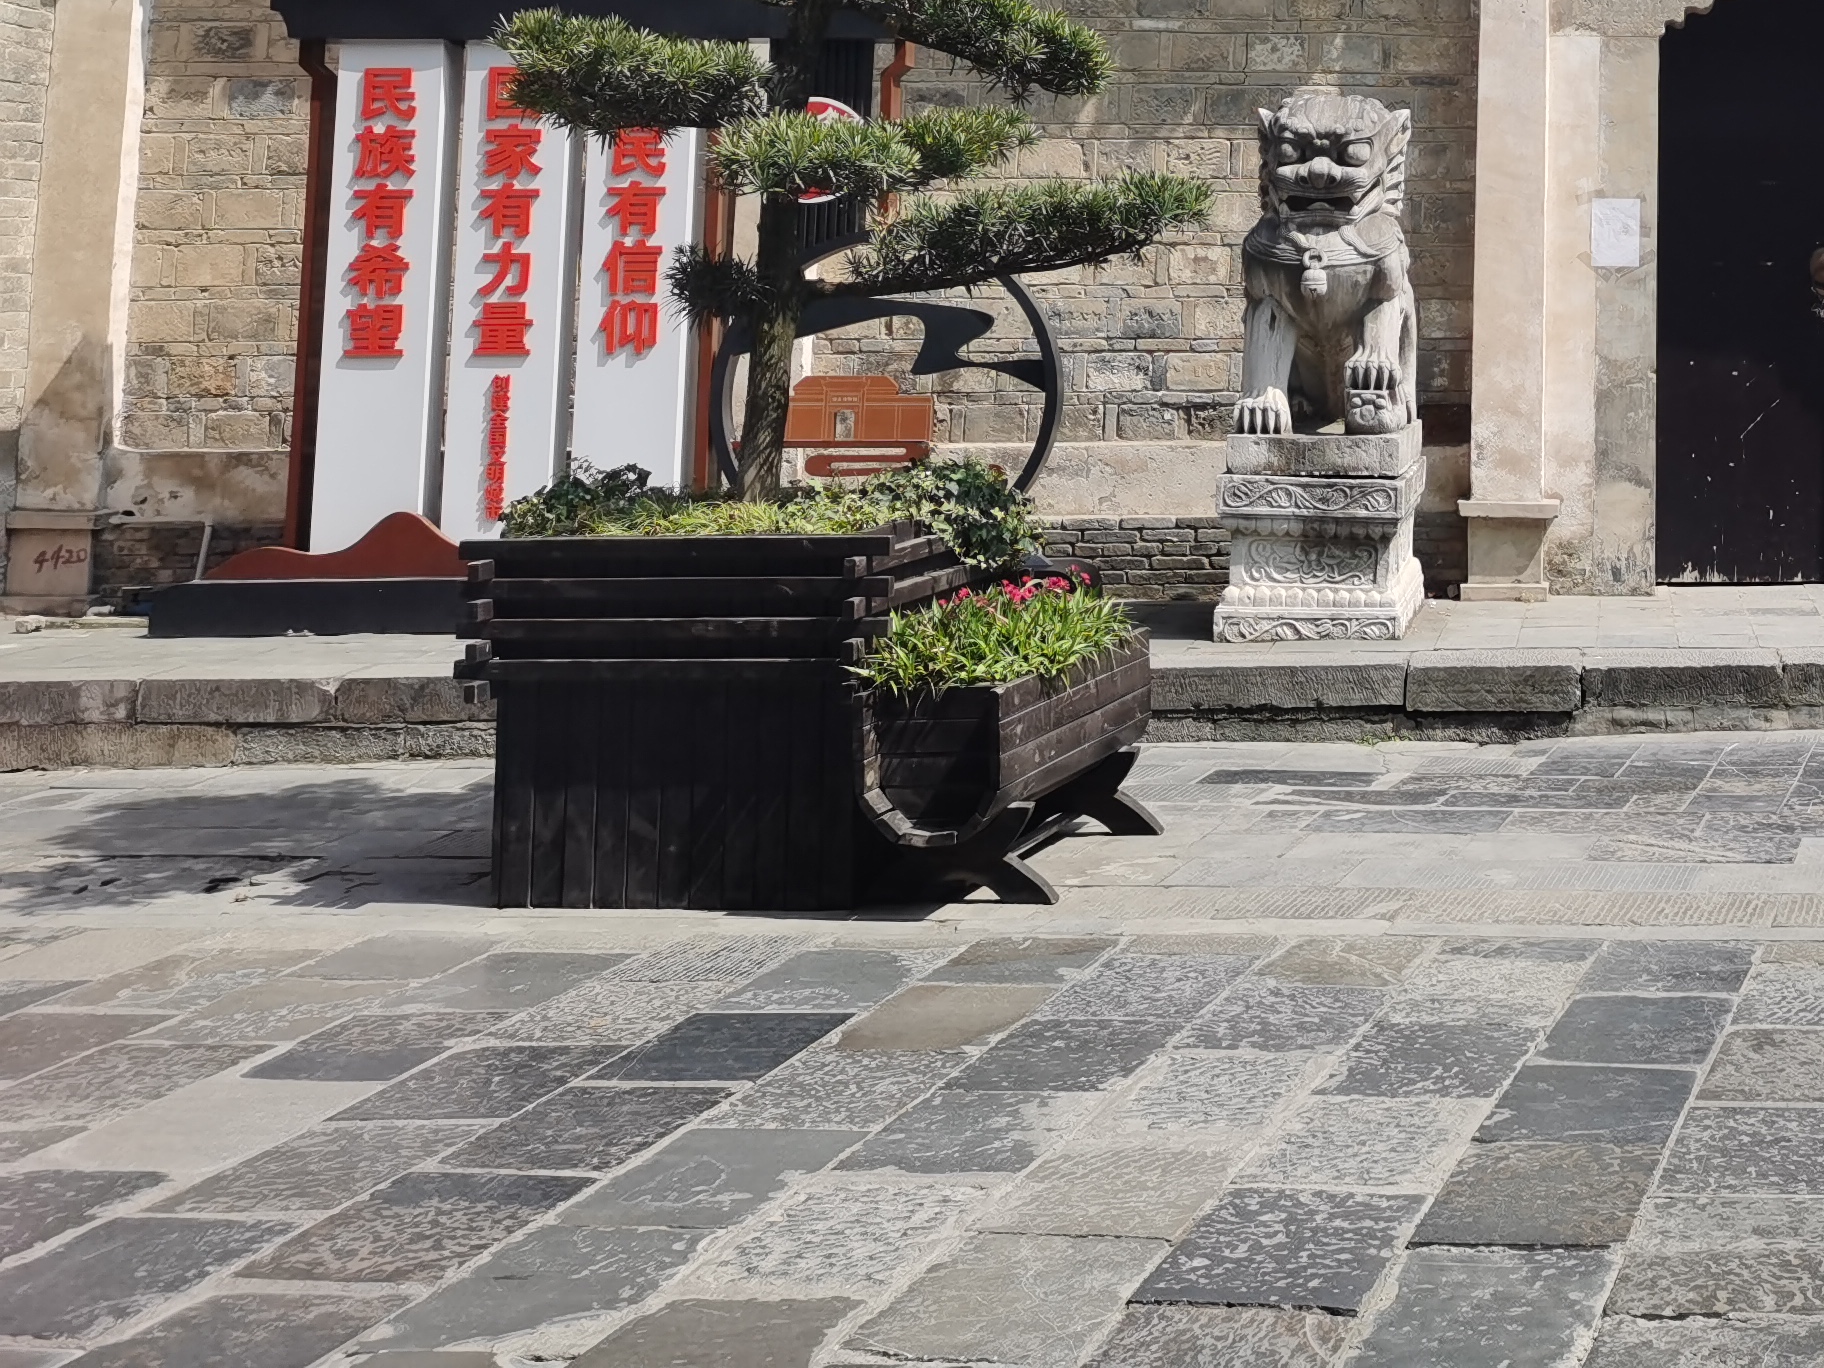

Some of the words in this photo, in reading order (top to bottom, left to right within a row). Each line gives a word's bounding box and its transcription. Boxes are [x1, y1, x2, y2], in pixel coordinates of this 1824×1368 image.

[343, 66, 418, 359] 民族有希望
[598, 126, 668, 355] 民有信仰
